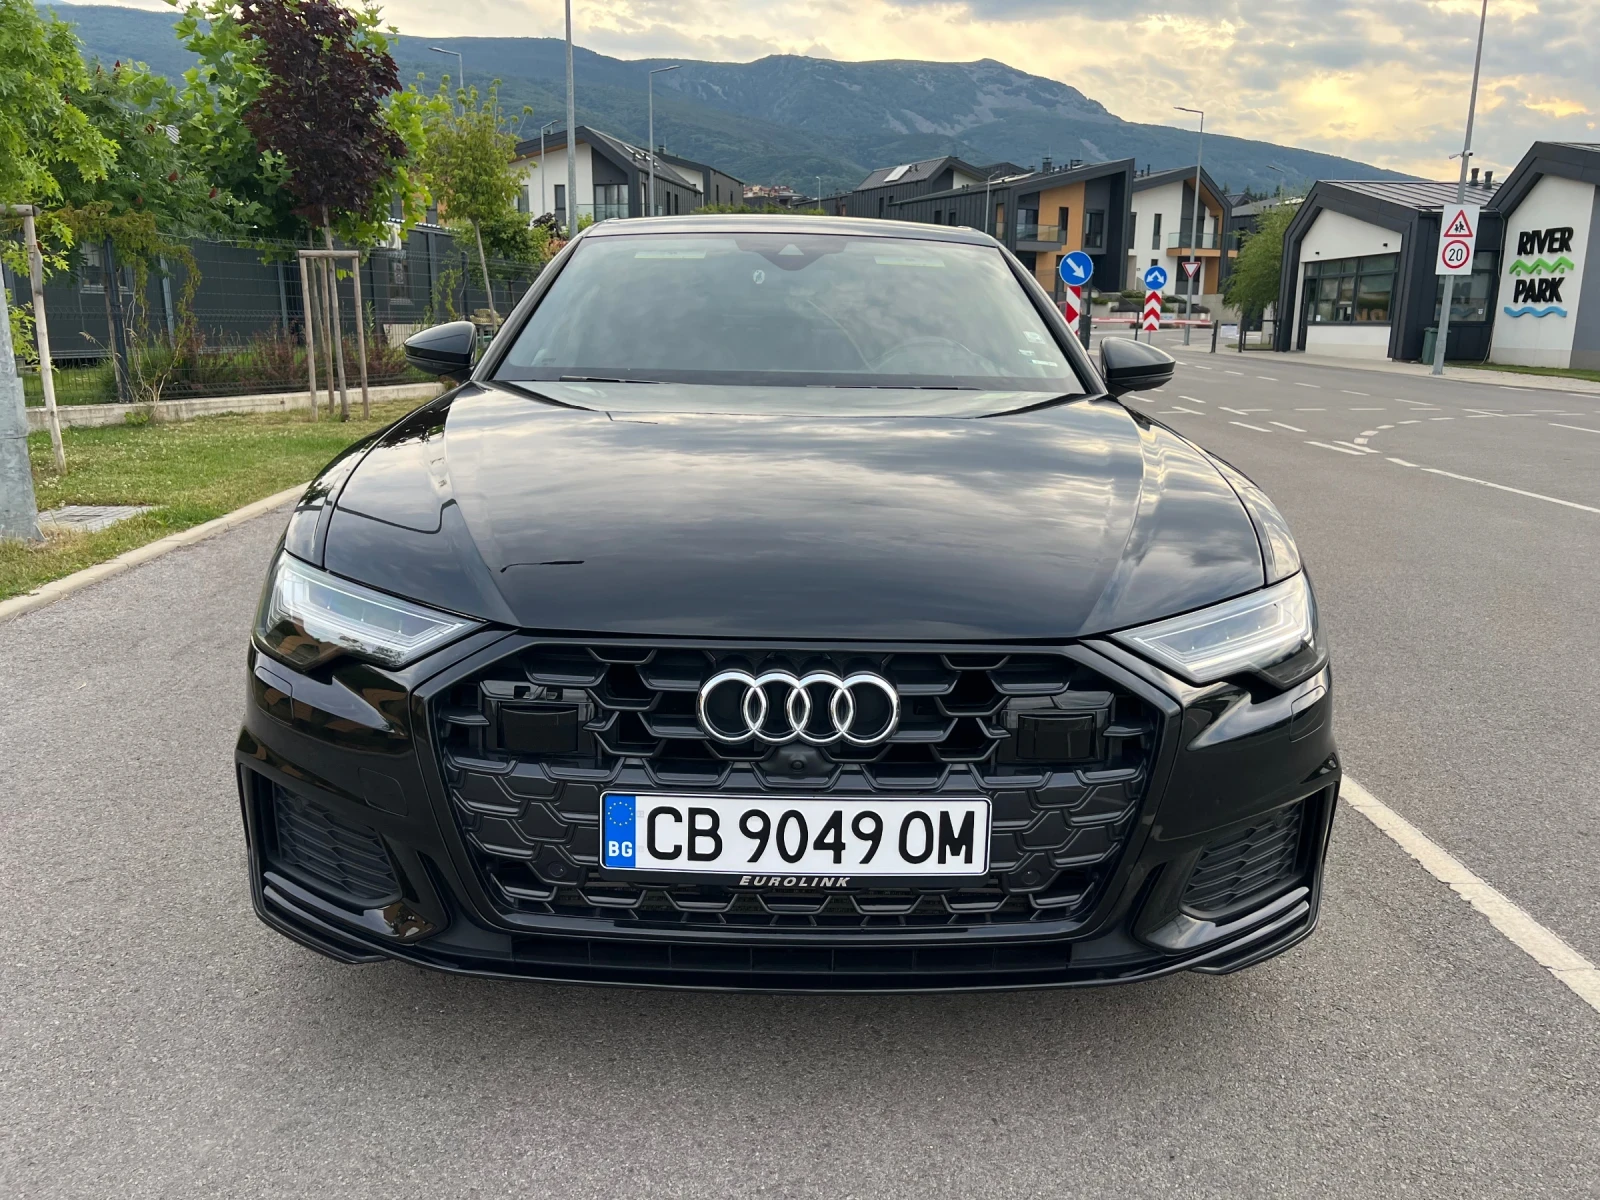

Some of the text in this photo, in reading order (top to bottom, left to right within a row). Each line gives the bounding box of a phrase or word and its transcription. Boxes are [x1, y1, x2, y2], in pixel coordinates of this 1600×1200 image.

[1517, 227, 1574, 256] RIVER
[1448, 248, 1463, 262] 20
[1513, 277, 1565, 303] PARK
[646, 805, 975, 865] CB 9049 OM
[607, 840, 633, 857] BG
[739, 875, 851, 887] EUROLINK
